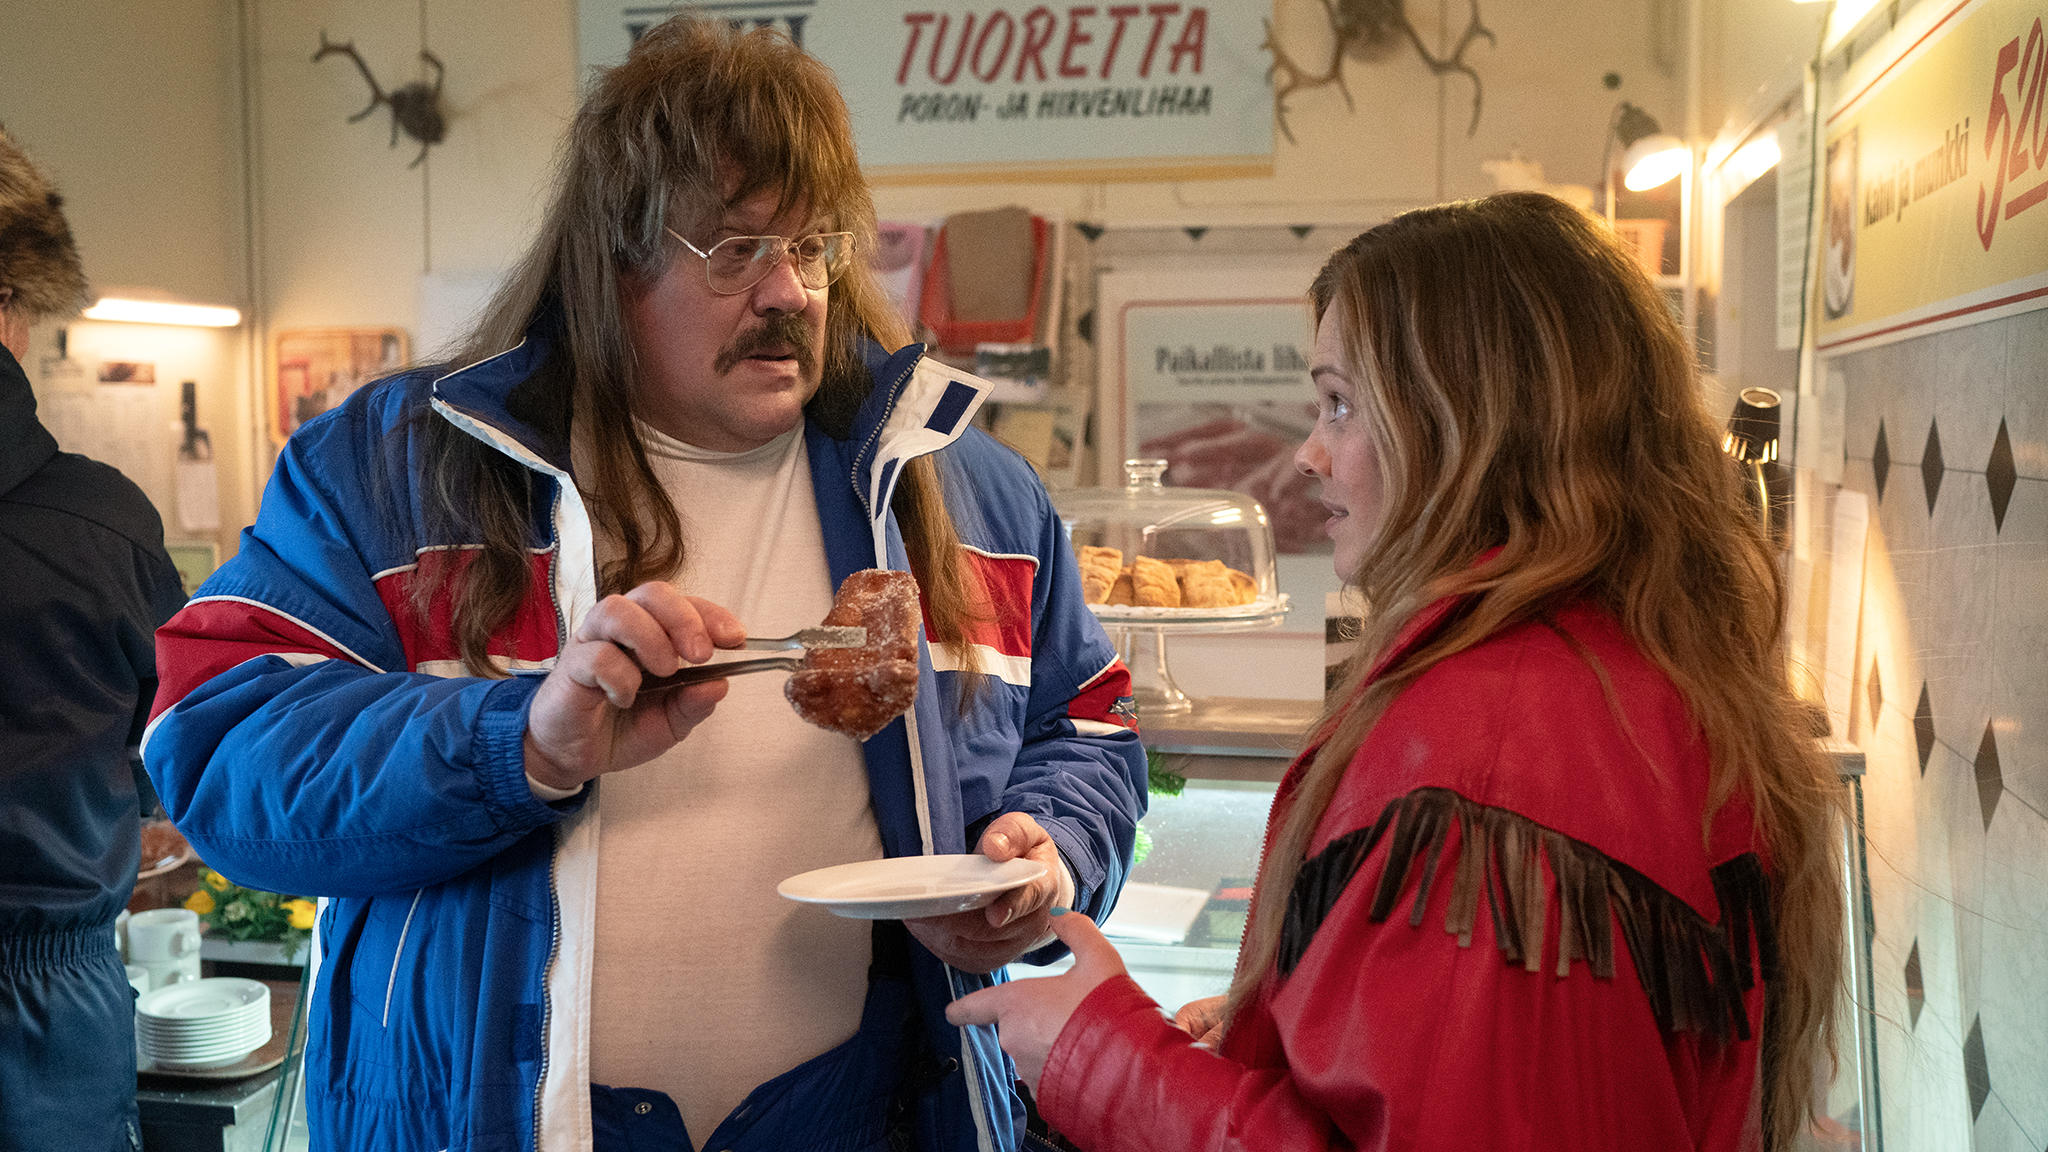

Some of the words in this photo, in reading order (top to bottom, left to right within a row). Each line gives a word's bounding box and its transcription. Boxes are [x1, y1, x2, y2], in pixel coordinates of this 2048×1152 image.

[896, 3, 1207, 85] TUORETTA
[997, 92, 1029, 120] JA
[1036, 85, 1212, 119] HIRVENLIHAA
